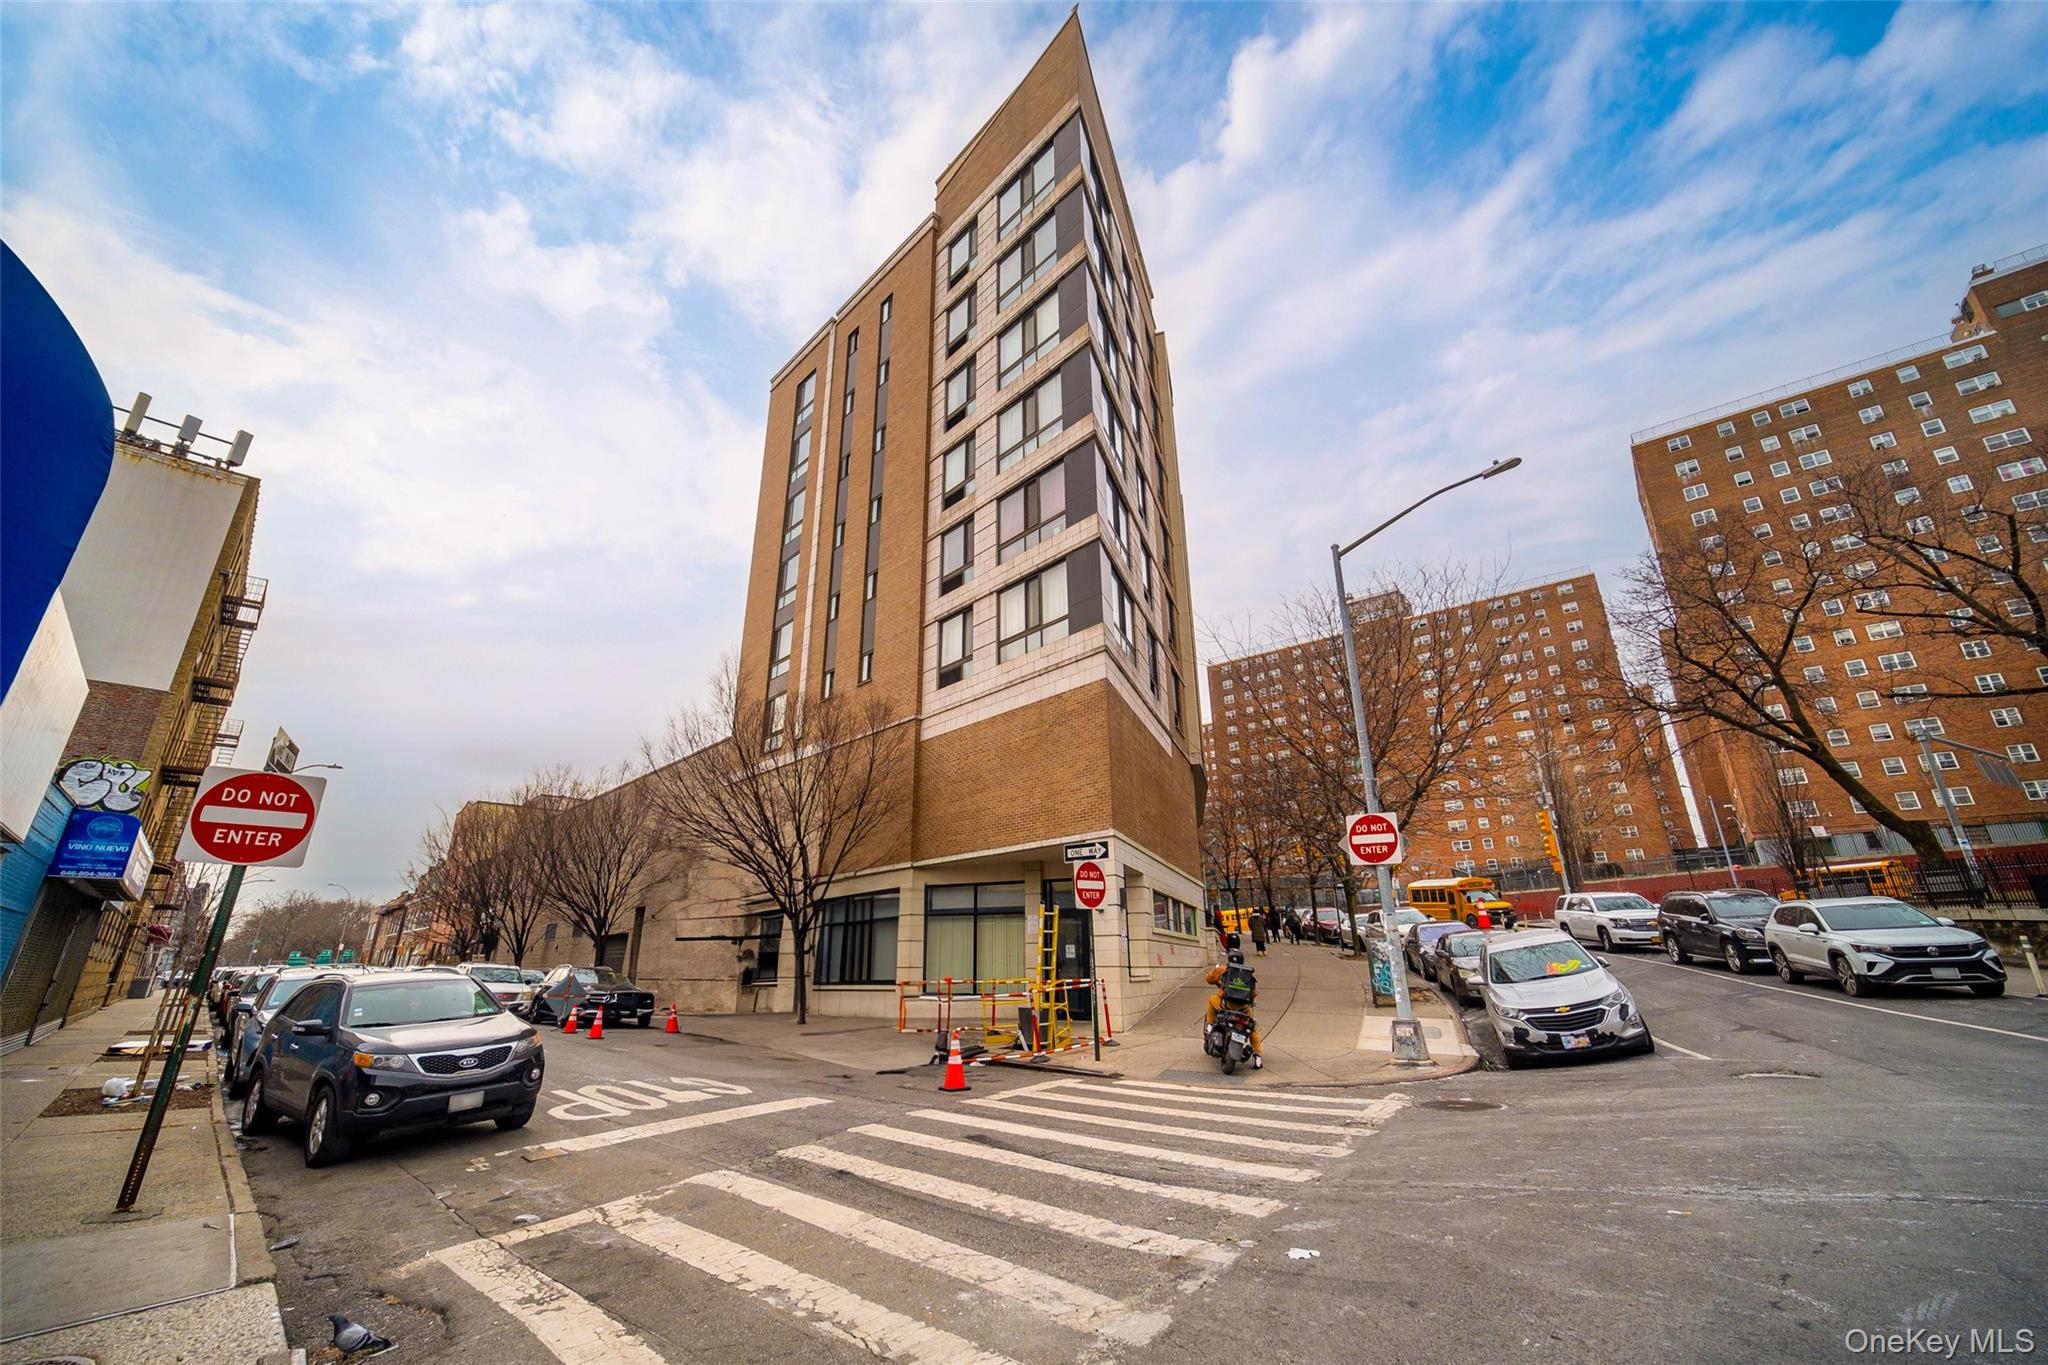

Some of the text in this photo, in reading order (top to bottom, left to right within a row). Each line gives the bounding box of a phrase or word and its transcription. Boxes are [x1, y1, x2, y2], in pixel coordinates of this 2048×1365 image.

[221, 787, 300, 807] DO NOT
[1355, 823, 1388, 833] DO NOT
[213, 829, 282, 847] ENTER
[68, 843, 93, 851] VINO
[94, 844, 130, 853] NUEVO
[1070, 847, 1102, 857] ONE WAY
[1360, 845, 1389, 854] ENTER
[1080, 870, 1100, 879] DO NOT
[1082, 891, 1100, 899] ENTER
[547, 1077, 753, 1121] STOP
